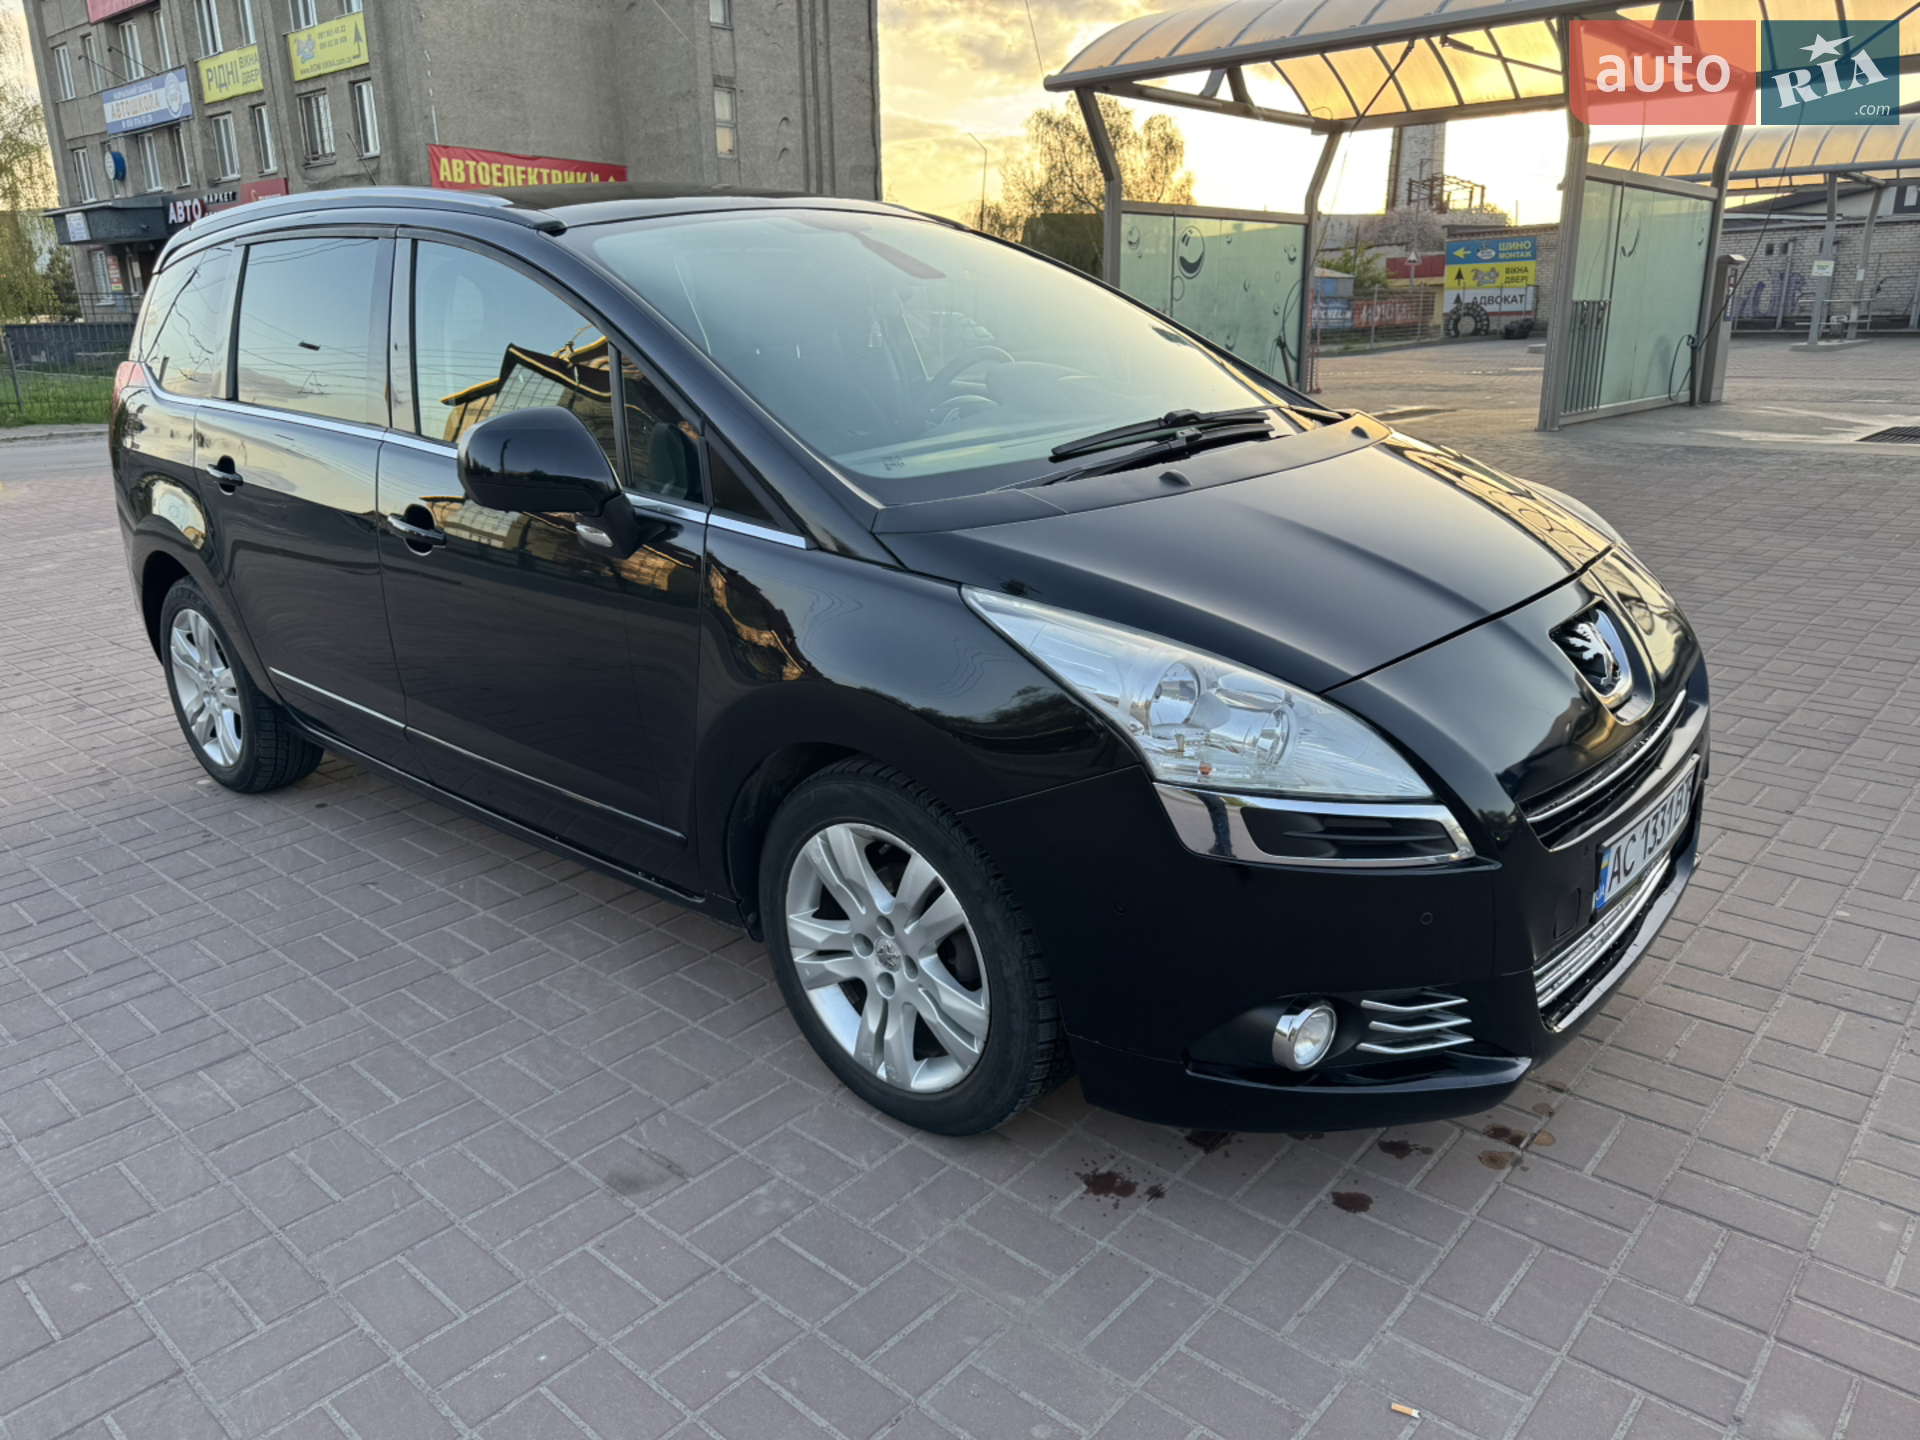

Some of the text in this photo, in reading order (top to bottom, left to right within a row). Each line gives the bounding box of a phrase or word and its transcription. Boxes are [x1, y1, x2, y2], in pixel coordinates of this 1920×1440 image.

[239, 52, 258, 69] ВІКНА
[206, 60, 239, 93] РІДНІ
[111, 92, 161, 120] АВТОШКОЛА
[203, 191, 234, 204] МАРКЕТ
[168, 198, 202, 224] АВТО
[1499, 240, 1532, 251] ШИНО
[1499, 251, 1532, 259] МОНТАЖ
[1505, 266, 1529, 275] ВІКНА
[1504, 276, 1529, 285] ДВЕРІ
[1471, 294, 1526, 306] АДВОКАТ
[1608, 833, 1637, 892] AC
